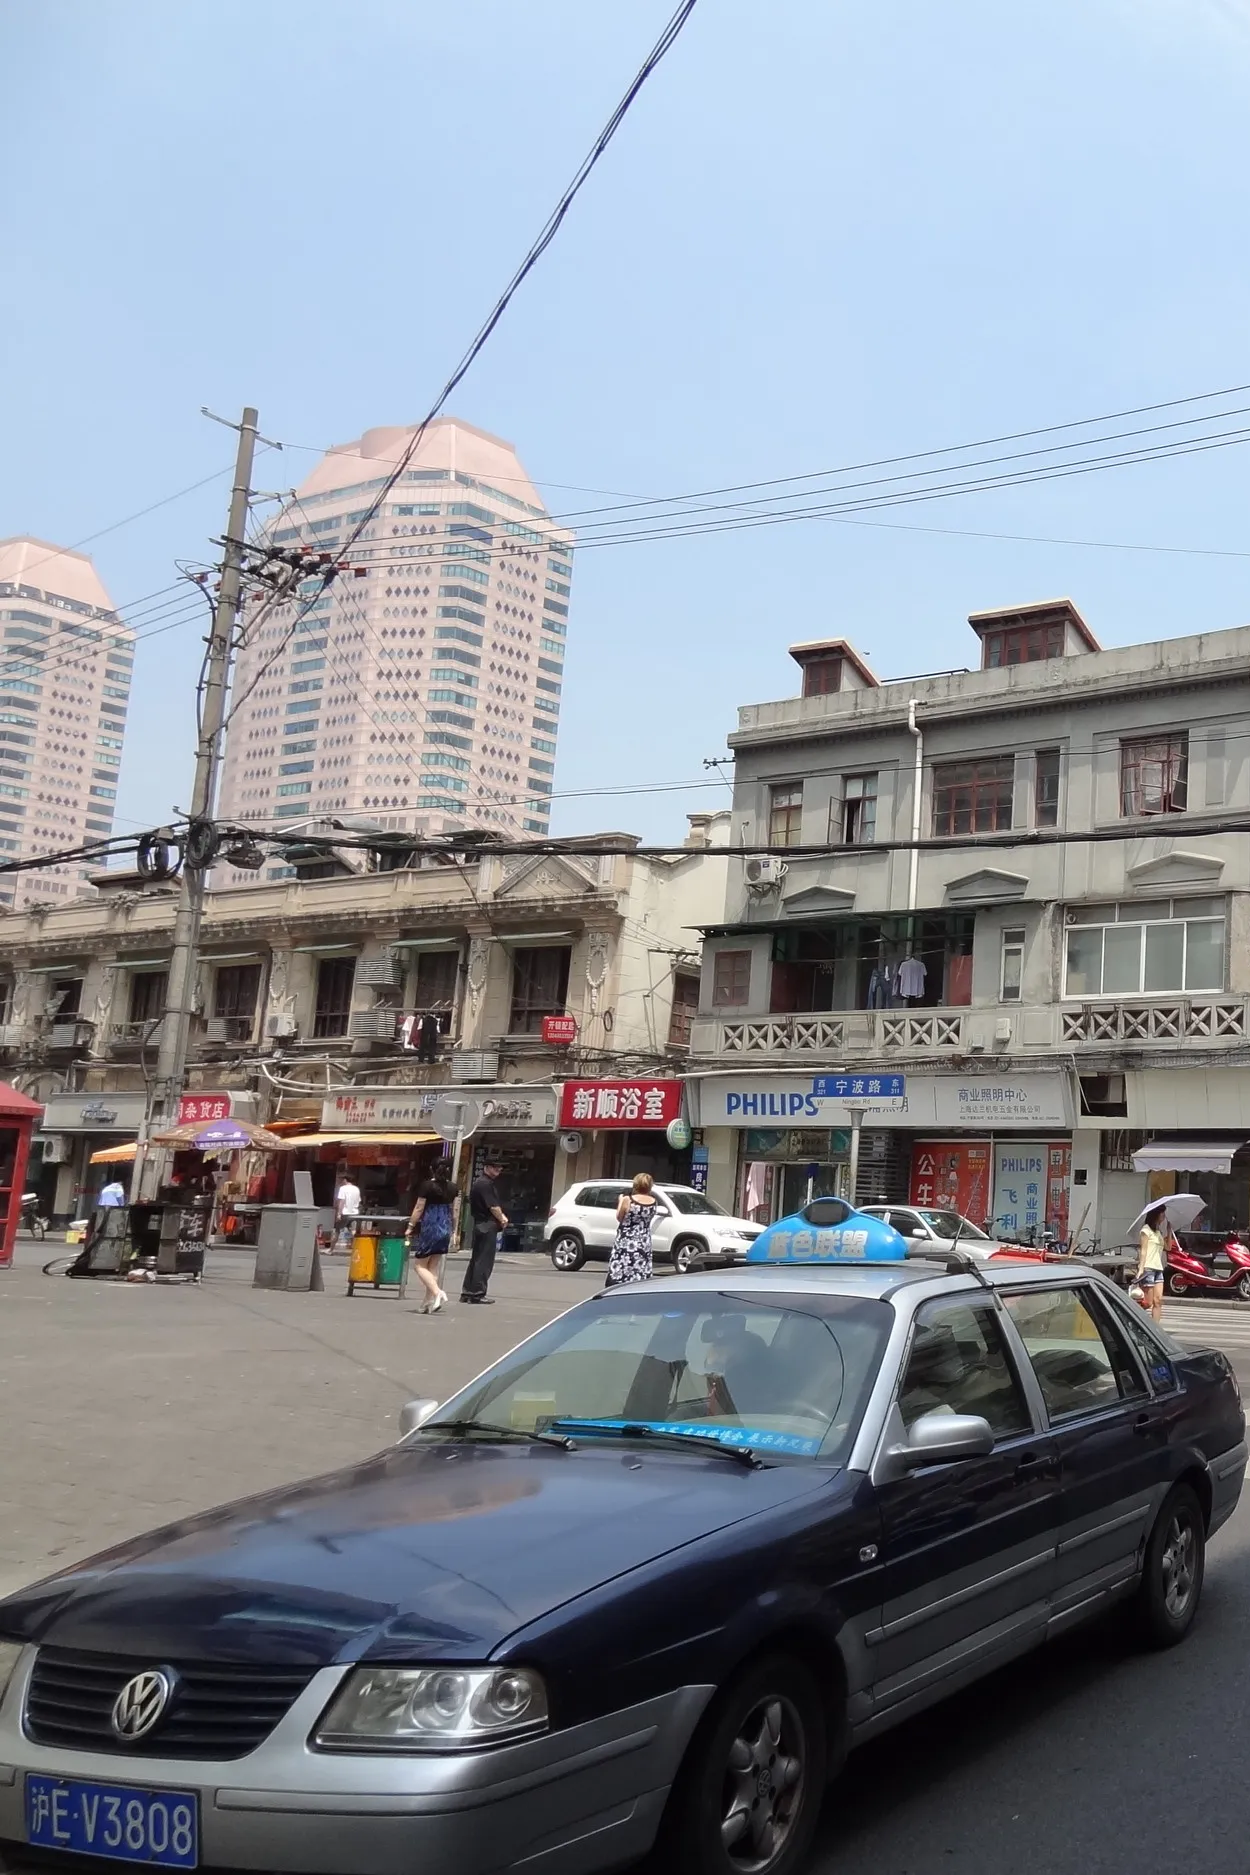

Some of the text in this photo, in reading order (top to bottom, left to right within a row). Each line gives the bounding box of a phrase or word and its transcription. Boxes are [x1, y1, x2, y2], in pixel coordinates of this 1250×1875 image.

[835, 1079, 882, 1094] 宁波路
[891, 1097, 897, 1105] E
[957, 1087, 1028, 1102] 商业照明中心
[572, 1087, 666, 1120] 新顺浴室
[726, 1092, 819, 1116] PHILIPS
[816, 1098, 825, 1107] W
[1001, 1158, 1042, 1172] PHILIPS
[917, 1154, 935, 1205] 公牛
[767, 1229, 869, 1259] 蓝色联盟
